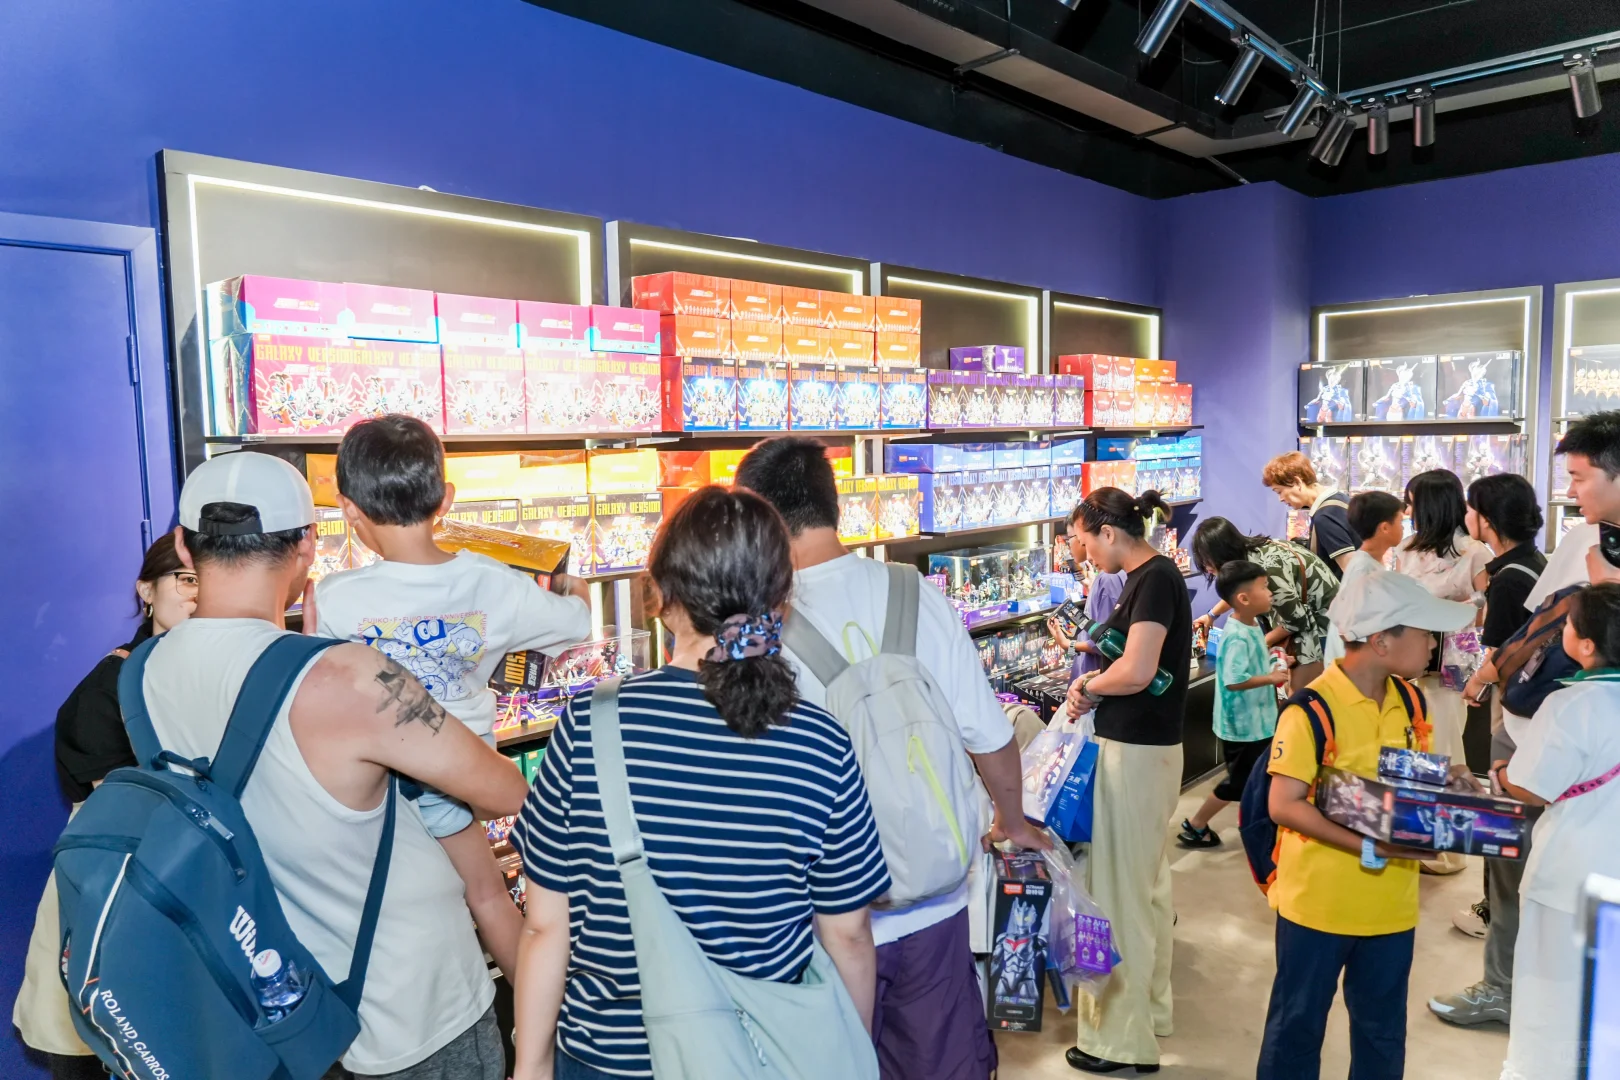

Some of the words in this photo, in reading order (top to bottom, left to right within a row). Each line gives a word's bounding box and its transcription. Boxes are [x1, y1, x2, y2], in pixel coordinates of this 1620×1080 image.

[256, 343, 302, 361] GALAXY
[307, 346, 351, 364] VERSION
[352, 350, 394, 366] GALAXY
[596, 360, 626, 374] GALAXY
[629, 362, 661, 376] VERSION
[522, 506, 554, 520] GALAXY
[557, 504, 590, 518] VERSION
[596, 502, 627, 516] GALAXY
[629, 500, 661, 514] VERSION
[482, 509, 518, 524] VERSION
[440, 609, 483, 620] ANNIVERSARY
[1273, 740, 1284, 760] 5
[100, 989, 138, 1040] ROLAND
[133, 1041, 170, 1080] GARROS
